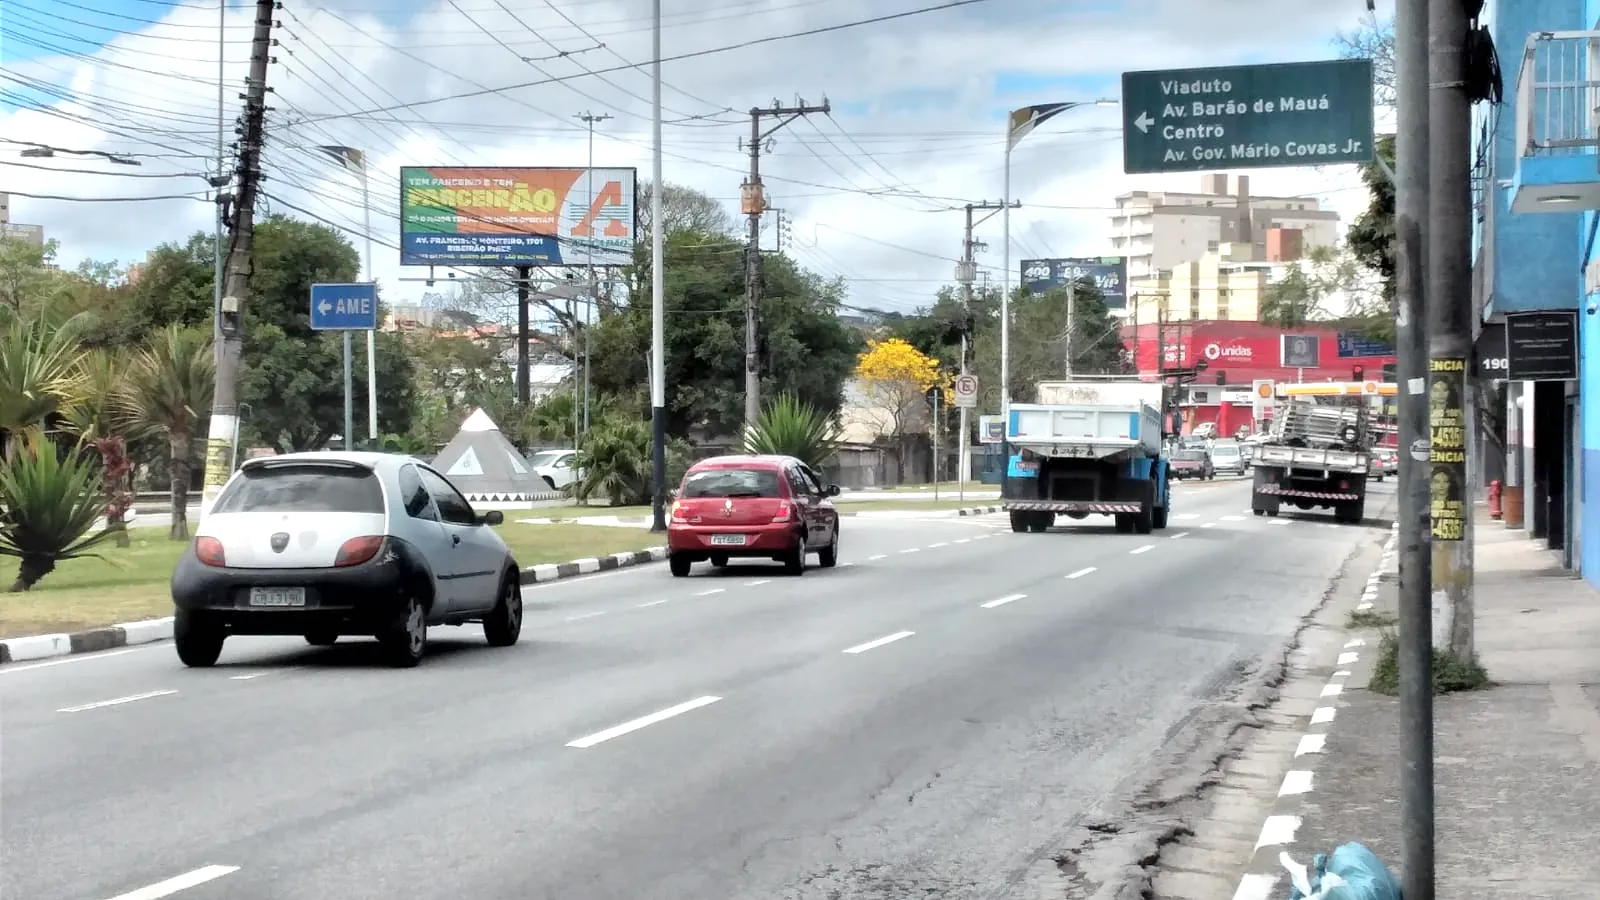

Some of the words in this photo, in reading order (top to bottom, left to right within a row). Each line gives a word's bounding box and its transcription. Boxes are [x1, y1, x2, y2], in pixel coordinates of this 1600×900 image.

[1160, 79, 1232, 95] Viaduto
[1162, 103, 1187, 118] Av.
[1192, 100, 1247, 116] Barão
[1253, 99, 1274, 113] de
[1280, 94, 1329, 112] Mauá
[1163, 124, 1225, 140] Centro
[1163, 149, 1187, 162] Av.
[1192, 146, 1226, 161] Gov.
[1231, 143, 1280, 159] Mário
[1285, 141, 1337, 157] Covas
[408, 178, 430, 186] TEM
[492, 178, 513, 186] TEM
[408, 182, 556, 213] PARCEIRÃO
[416, 237, 429, 245] AV.
[526, 238, 543, 246] 1701
[447, 244, 485, 252] RIBEIRÃO
[1024, 266, 1051, 278] 400
[335, 298, 370, 314] AME
[1221, 345, 1252, 356] unidas
